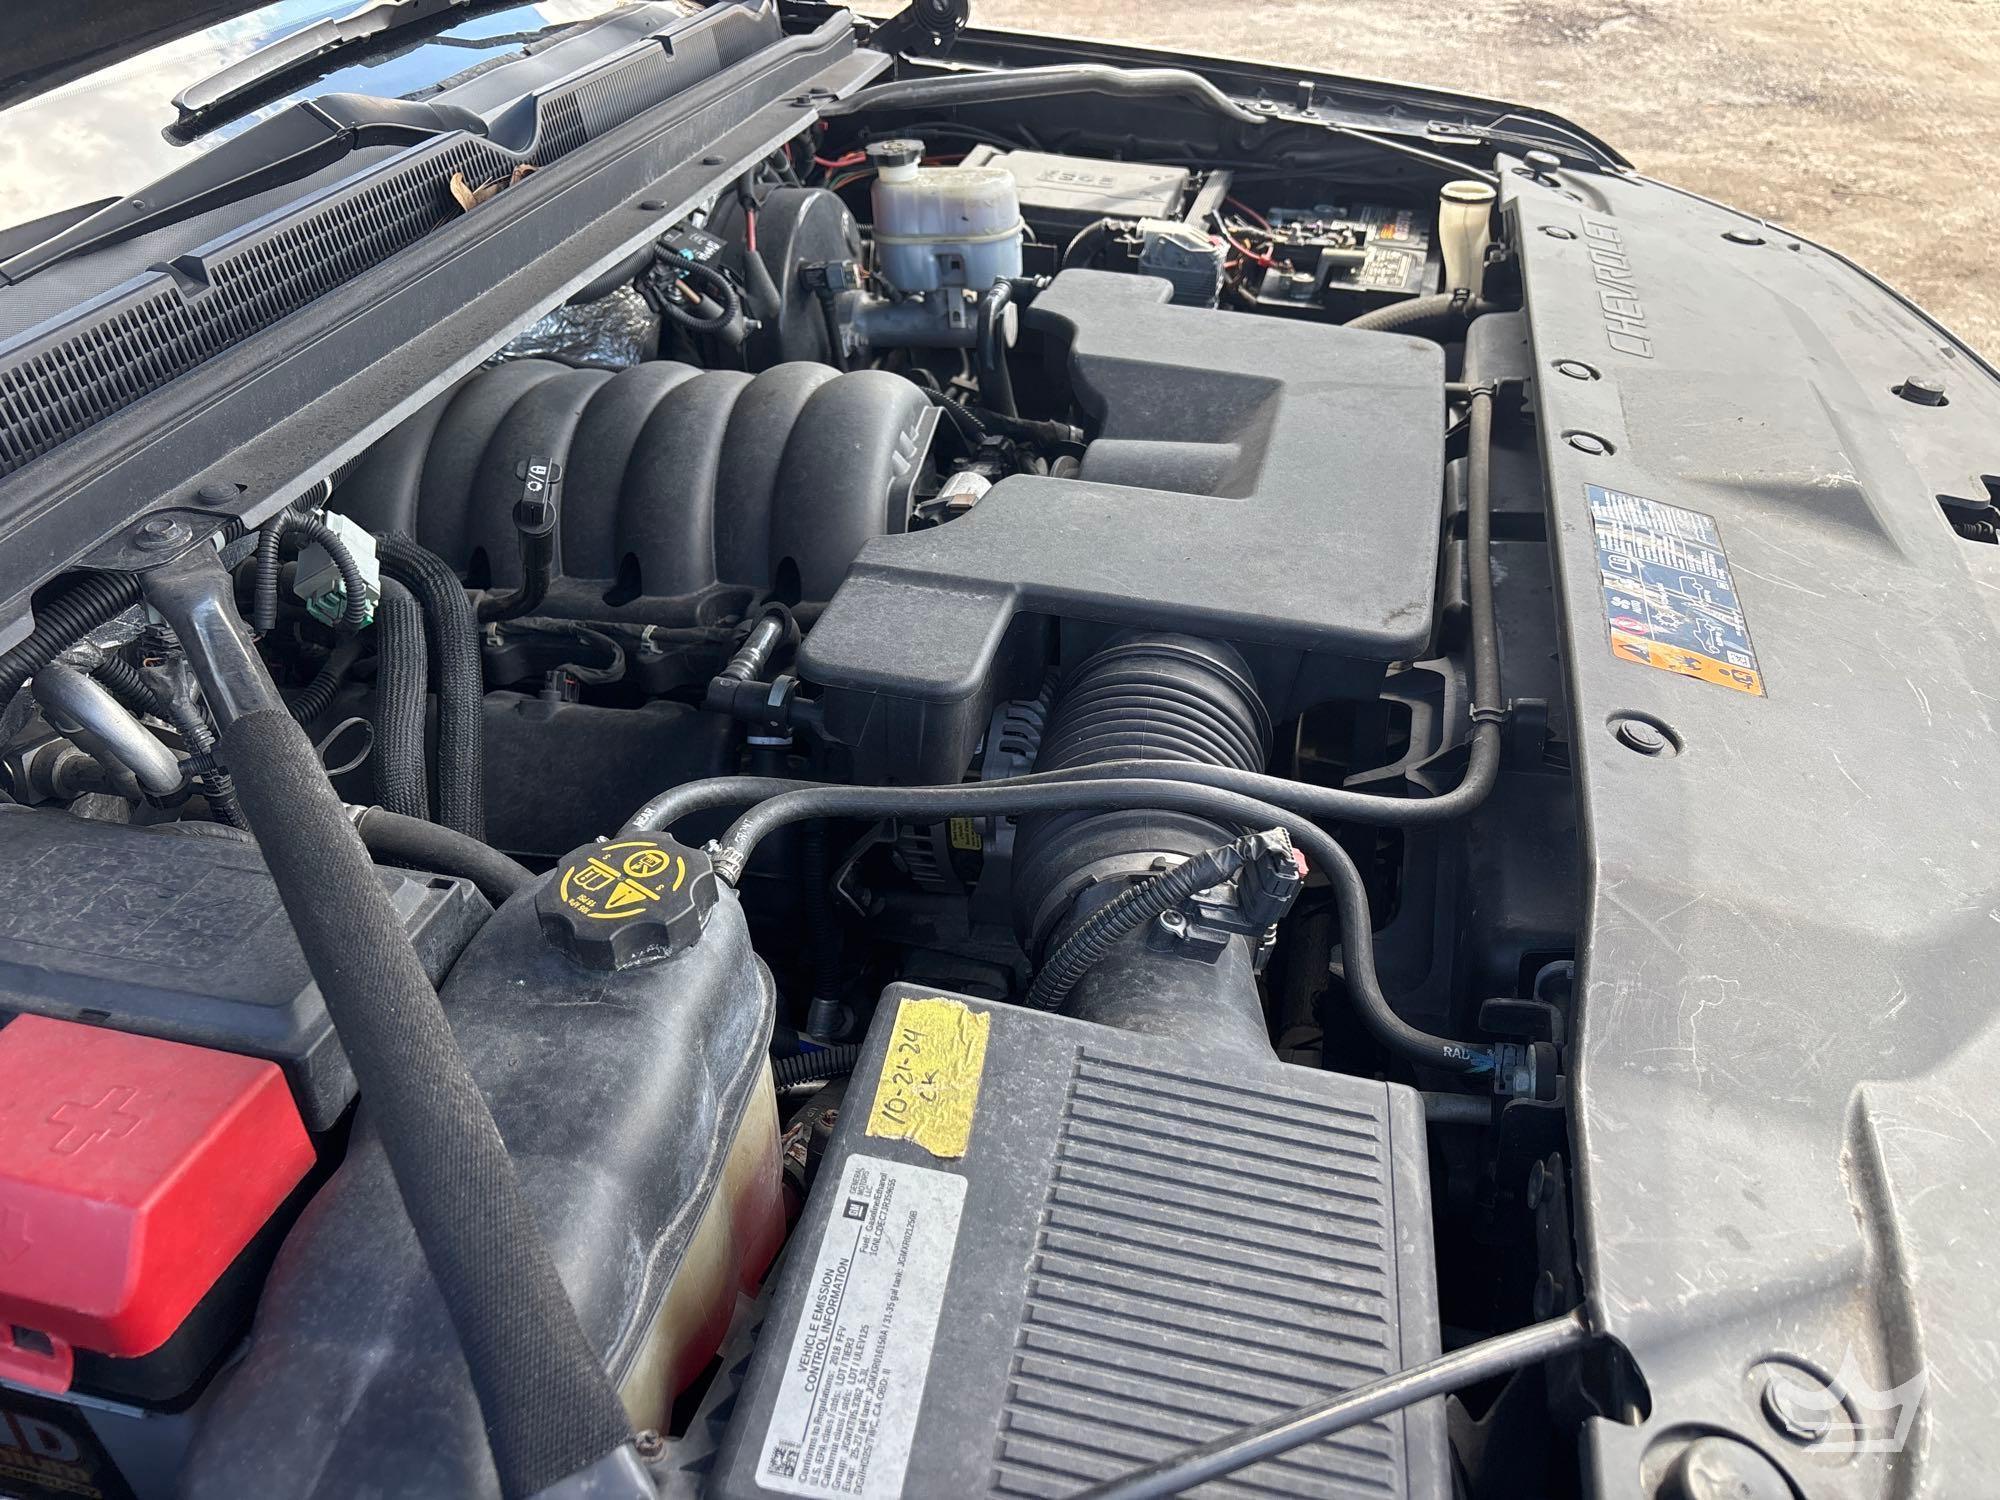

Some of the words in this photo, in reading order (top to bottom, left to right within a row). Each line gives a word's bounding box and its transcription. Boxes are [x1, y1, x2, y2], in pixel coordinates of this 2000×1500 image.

[1579, 214, 1655, 359] CHEVROLET
[882, 1028, 927, 1124] 10-21-24
[849, 1167, 864, 1194] GENERAL
[856, 1169, 869, 1195] MOTORS
[863, 1184, 873, 1197] LLC
[848, 1203, 860, 1216] GM
[859, 1234, 871, 1253] Fuel:
[892, 1268, 903, 1287] tank:
[889, 1288, 898, 1301] gal
[797, 1323, 819, 1371] VEHICLE
[811, 1268, 834, 1321] EMISSION
[882, 1301, 895, 1323] 31-35
[804, 1336, 827, 1392] CONTROL
[821, 1257, 848, 1332] INFORMATION
[857, 1367, 869, 1383] 5.3L
[875, 1376, 888, 1400] OBD:
[798, 1437, 817, 1483] Conforms
[813, 1370, 835, 1424] Regulations:
[829, 1345, 841, 1365] 2018
[835, 1325, 846, 1342] FFV
[814, 1444, 827, 1464] EPA
[821, 1418, 834, 1443] class
[834, 1367, 847, 1386] LDT
[841, 1337, 854, 1361] TIER3
[820, 1442, 838, 1487] California
[833, 1417, 845, 1441] class
[846, 1365, 858, 1385] LDT
[852, 1324, 869, 1361] ULEV125
[860, 1395, 872, 1418] tank:
[872, 1402, 882, 1417] CA
[857, 1418, 868, 1434] gal
